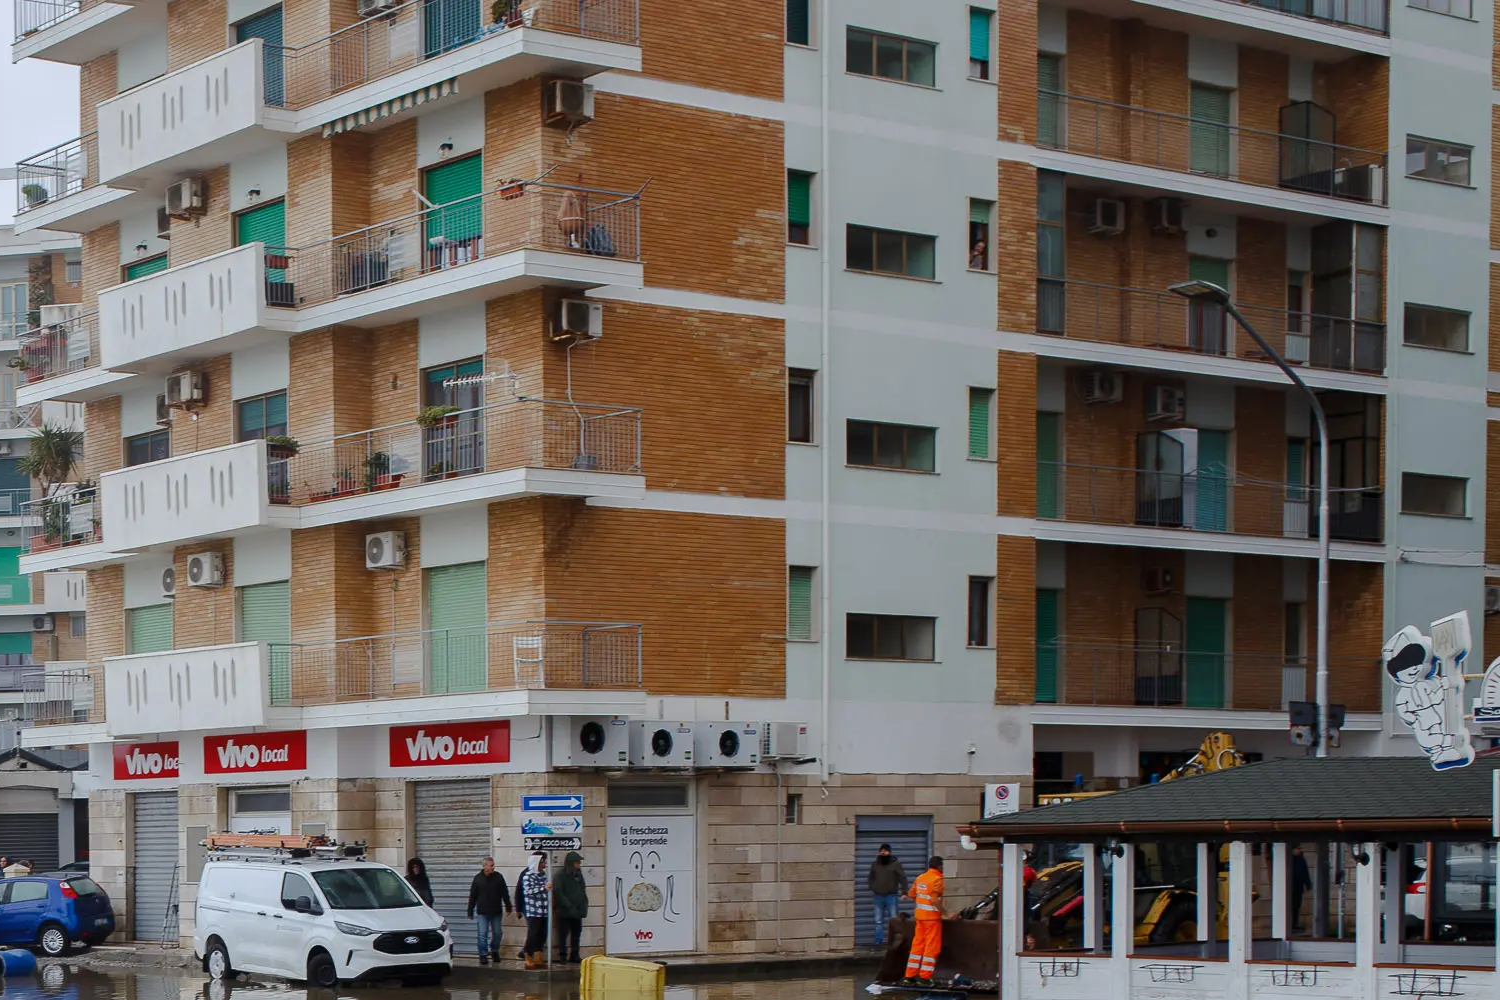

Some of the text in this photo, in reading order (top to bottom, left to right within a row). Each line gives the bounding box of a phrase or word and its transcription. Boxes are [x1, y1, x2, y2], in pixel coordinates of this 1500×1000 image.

[457, 735, 489, 755] local
[261, 744, 289, 762] local
[620, 826, 668, 835] la freschezza
[621, 836, 668, 847] ti sorprende
